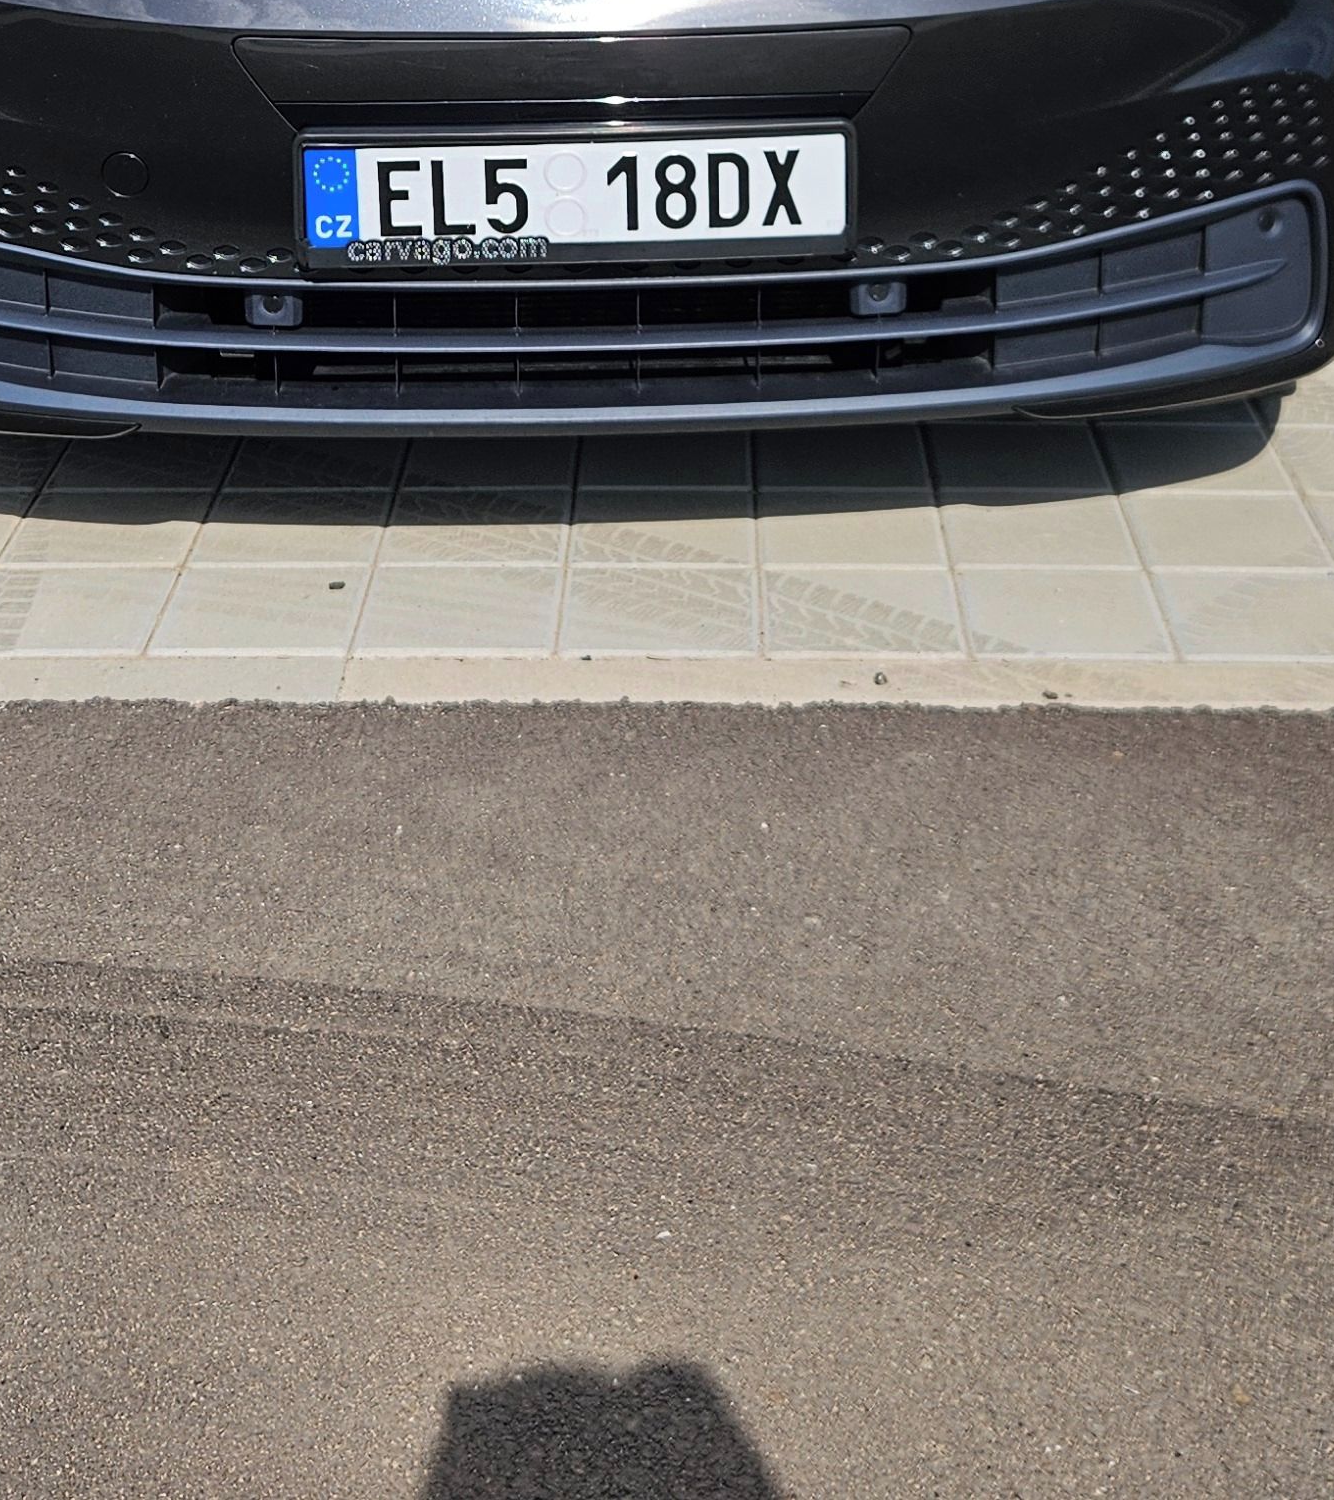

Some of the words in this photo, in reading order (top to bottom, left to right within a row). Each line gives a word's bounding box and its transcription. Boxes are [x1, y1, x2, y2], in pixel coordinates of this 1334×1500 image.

[376, 158, 530, 237] EL5
[606, 149, 803, 231] 18DX
[315, 215, 353, 238] CZ
[347, 236, 548, 266] carvago.com
